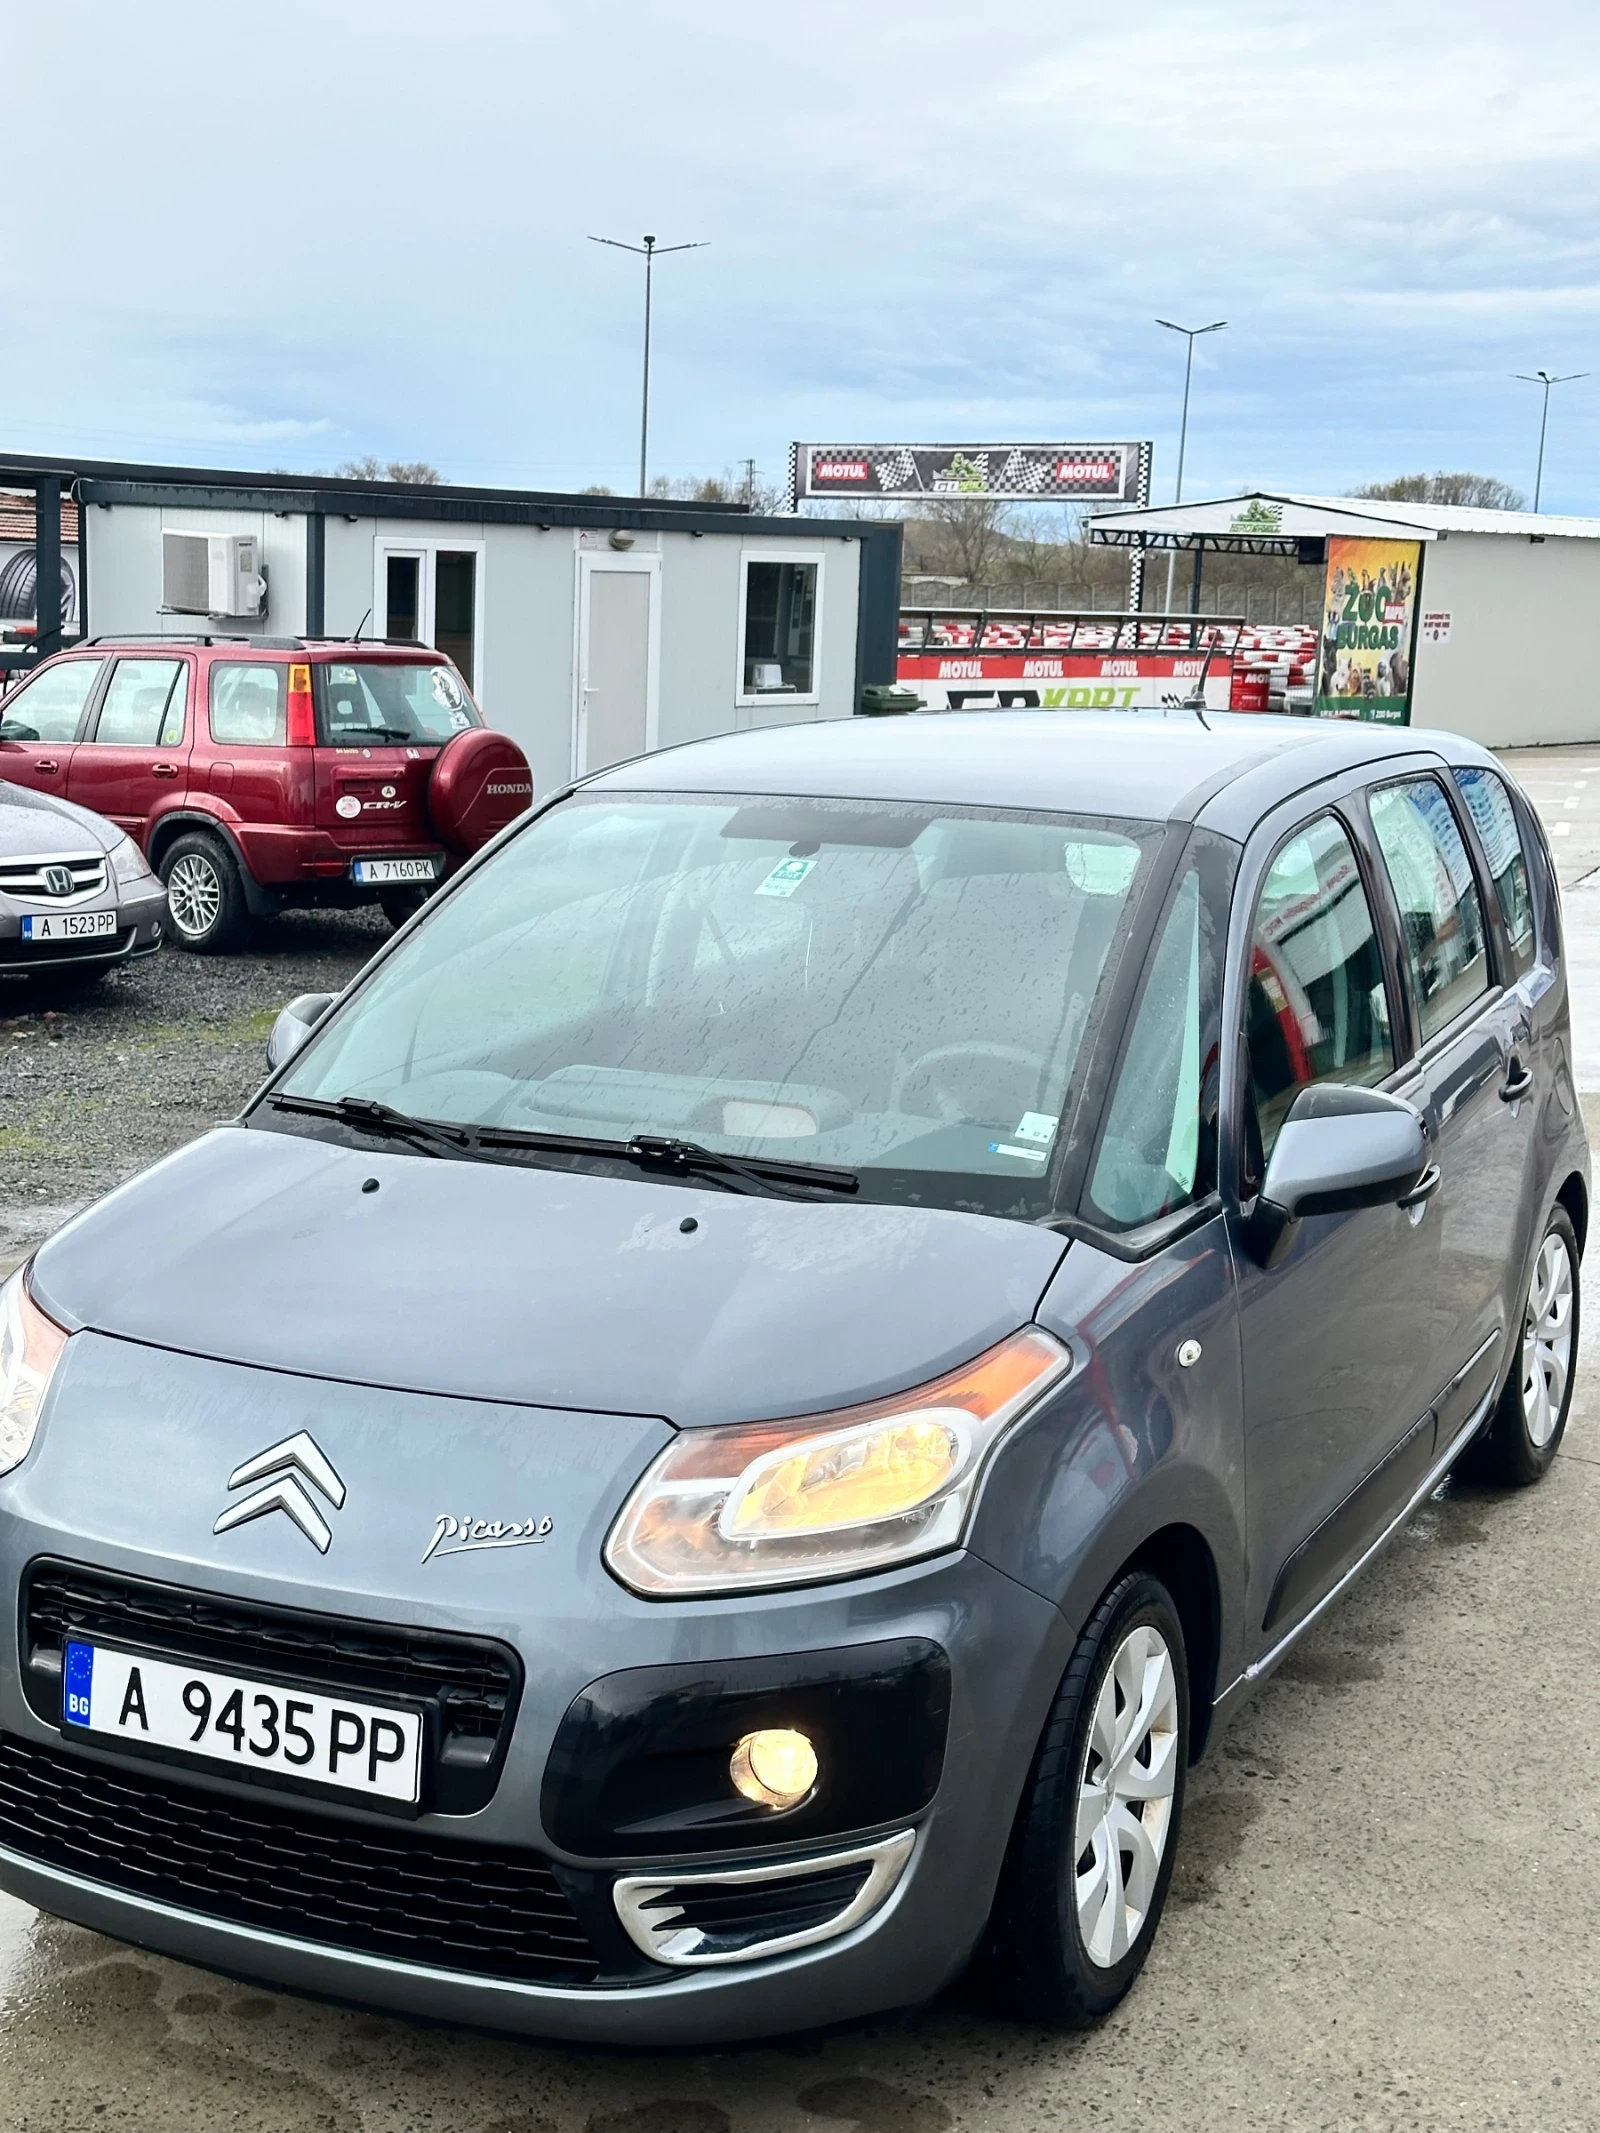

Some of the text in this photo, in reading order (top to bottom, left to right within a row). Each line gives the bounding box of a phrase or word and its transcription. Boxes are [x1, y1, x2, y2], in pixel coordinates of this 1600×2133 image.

[820, 464, 865, 478] MOTUL
[1060, 464, 1110, 479] MOTUL
[1342, 584, 1392, 623] ZOO
[1336, 622, 1399, 650] BURGAS
[938, 660, 1205, 678] MOTUL MOTUL MOTUL MOTU
[487, 783, 532, 794] HONDA
[421, 1513, 553, 1564] Picasso
[69, 1693, 89, 1716] BG
[119, 1666, 149, 1731] A
